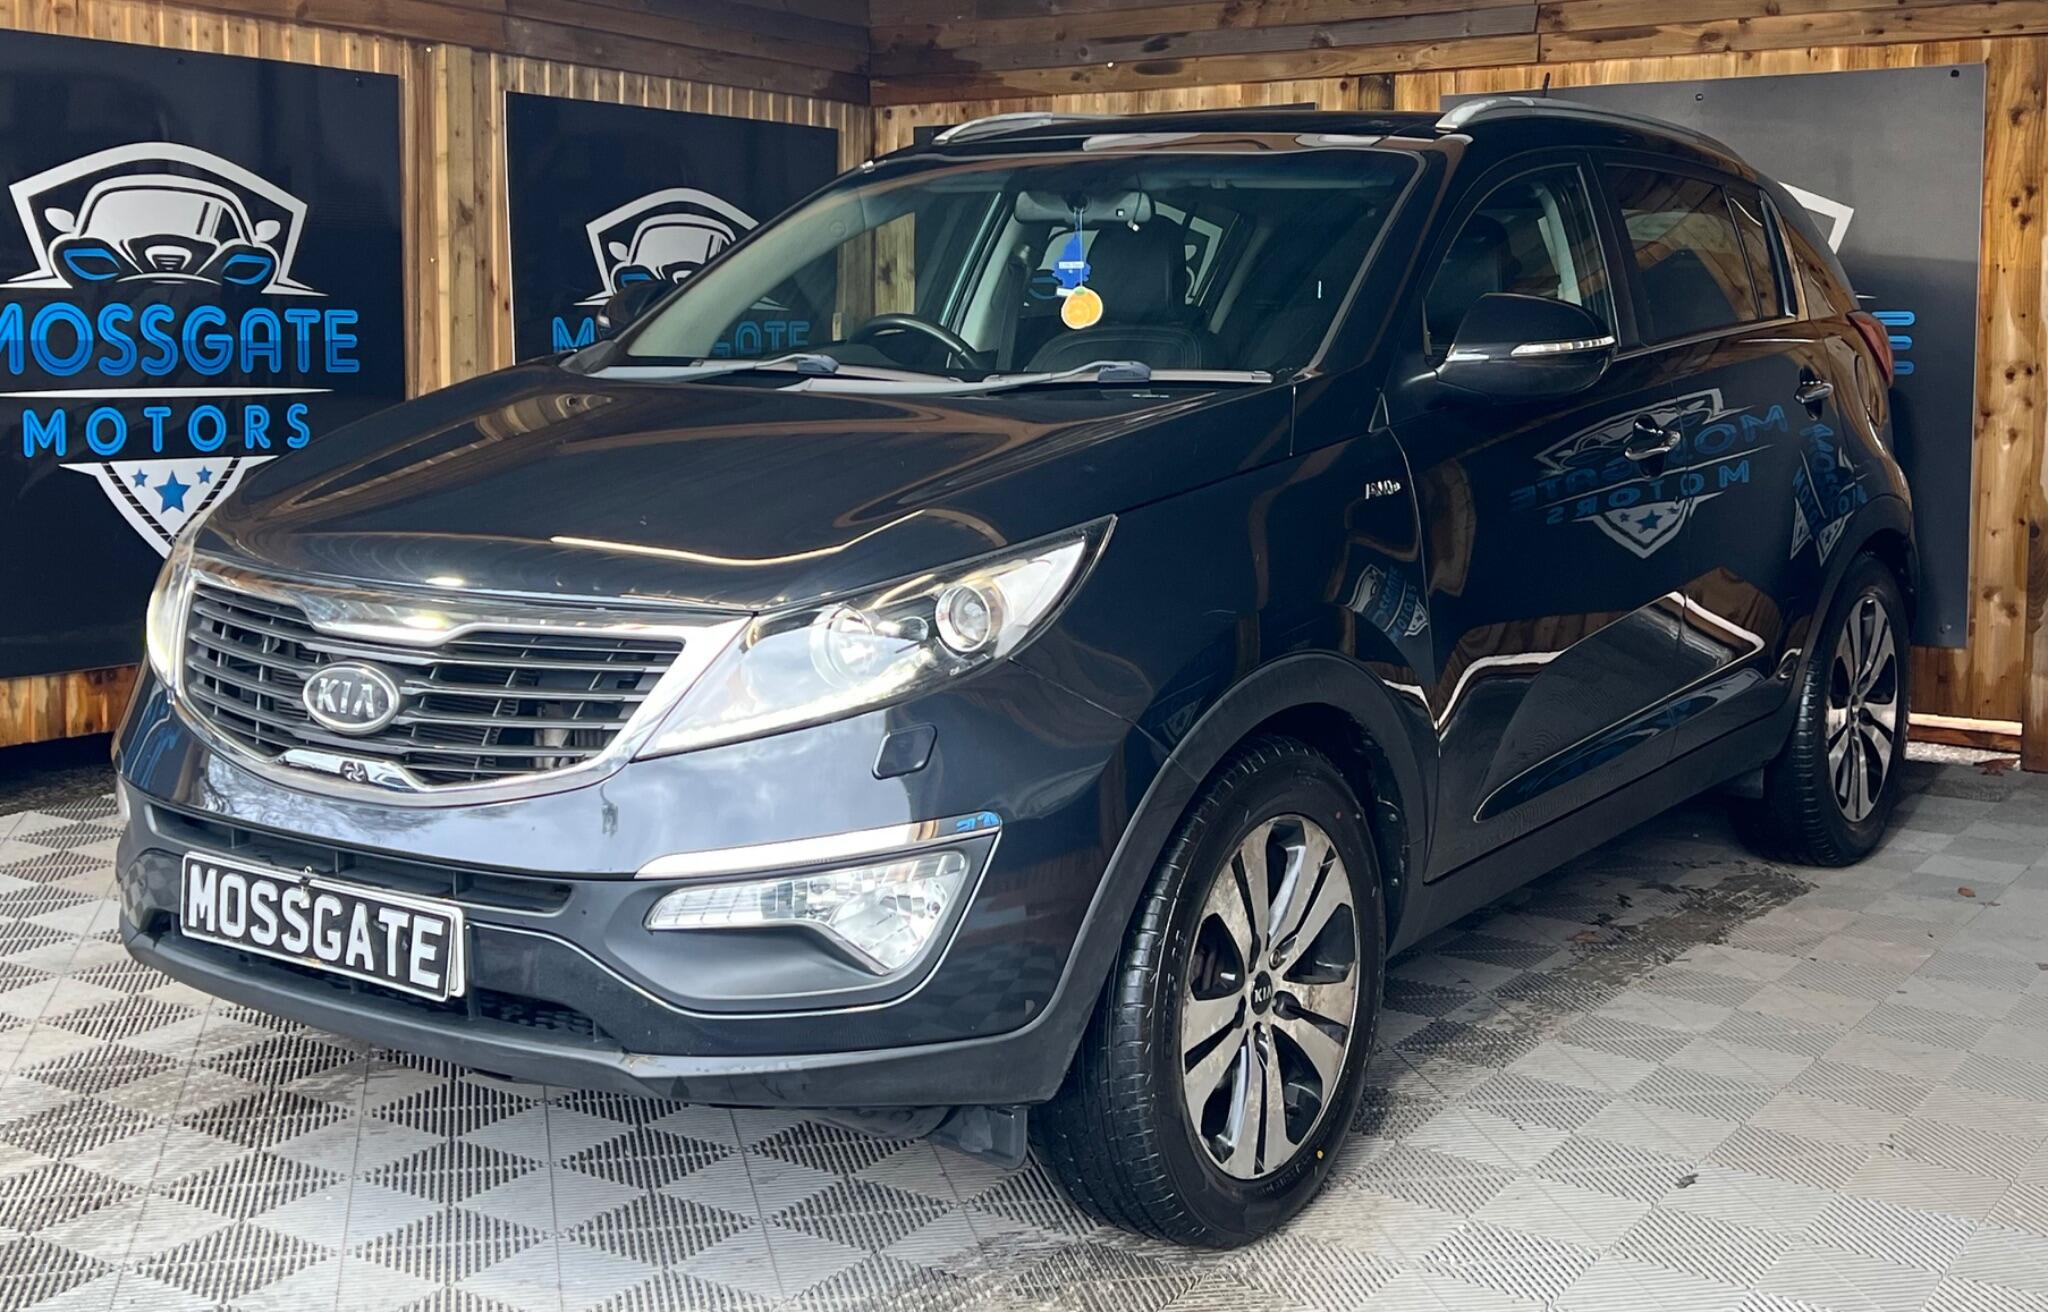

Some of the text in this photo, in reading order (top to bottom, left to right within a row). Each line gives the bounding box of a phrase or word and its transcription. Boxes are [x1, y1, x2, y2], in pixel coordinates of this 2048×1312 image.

[22, 403, 311, 458] MOTORS
[316, 677, 376, 719] KIA
[187, 863, 445, 990] MOSSGATE
